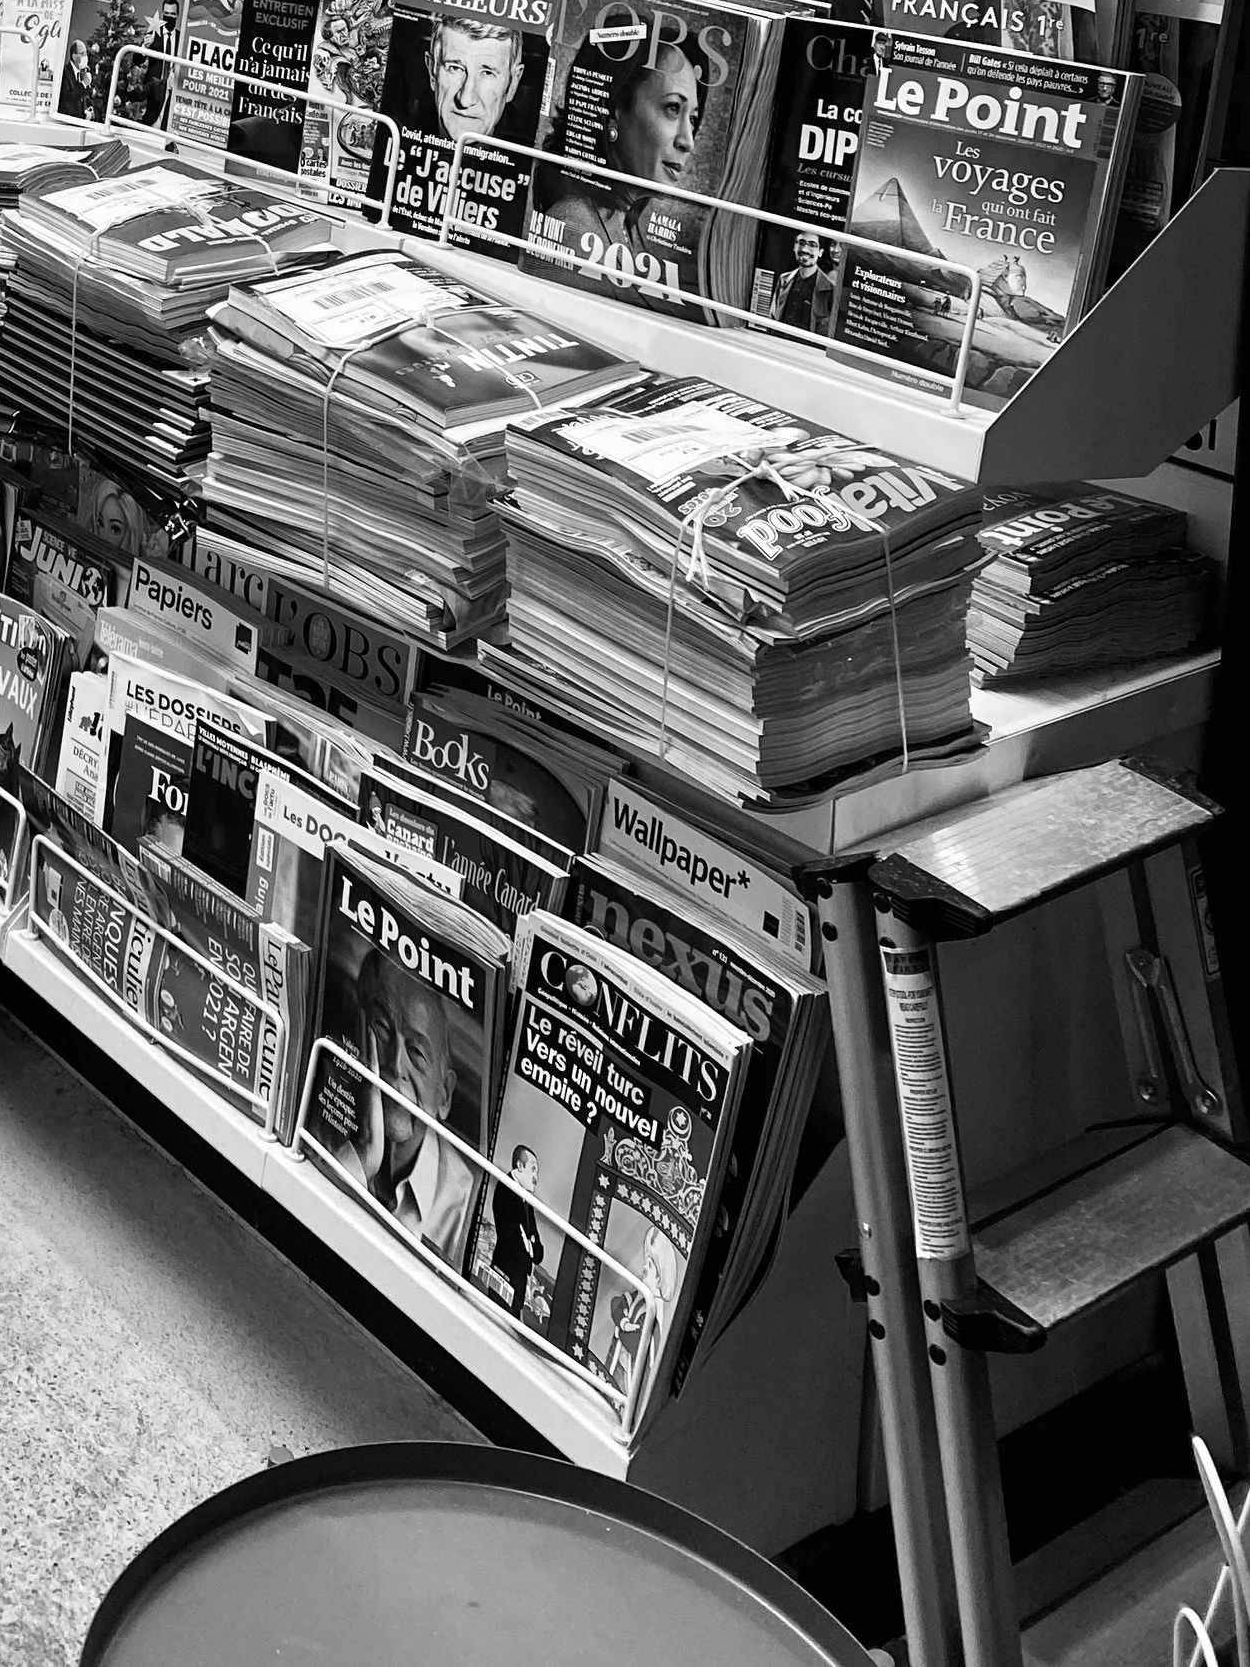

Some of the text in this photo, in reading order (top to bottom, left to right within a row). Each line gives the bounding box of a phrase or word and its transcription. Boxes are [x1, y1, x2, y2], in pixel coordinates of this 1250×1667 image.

[256, 13, 308, 31] EXCLUSIF
[239, 96, 303, 124] Français
[874, 67, 924, 115] Le
[931, 77, 1087, 148] Point
[933, 153, 1065, 205] voyages
[956, 142, 981, 158] Les
[931, 200, 1056, 256] la France
[981, 198, 1057, 227] qui ont fait
[855, 264, 903, 291] Explorateurs
[134, 568, 213, 632] Papiers
[413, 719, 490, 789] Books
[339, 875, 475, 1009] Le Point
[589, 884, 778, 1043] nexus
[527, 1003, 645, 1103] Le réveil turc
[538, 949, 720, 1102] CONFLITS
[521, 1054, 582, 1113] empire
[525, 1030, 659, 1143] Vers un nouvel
